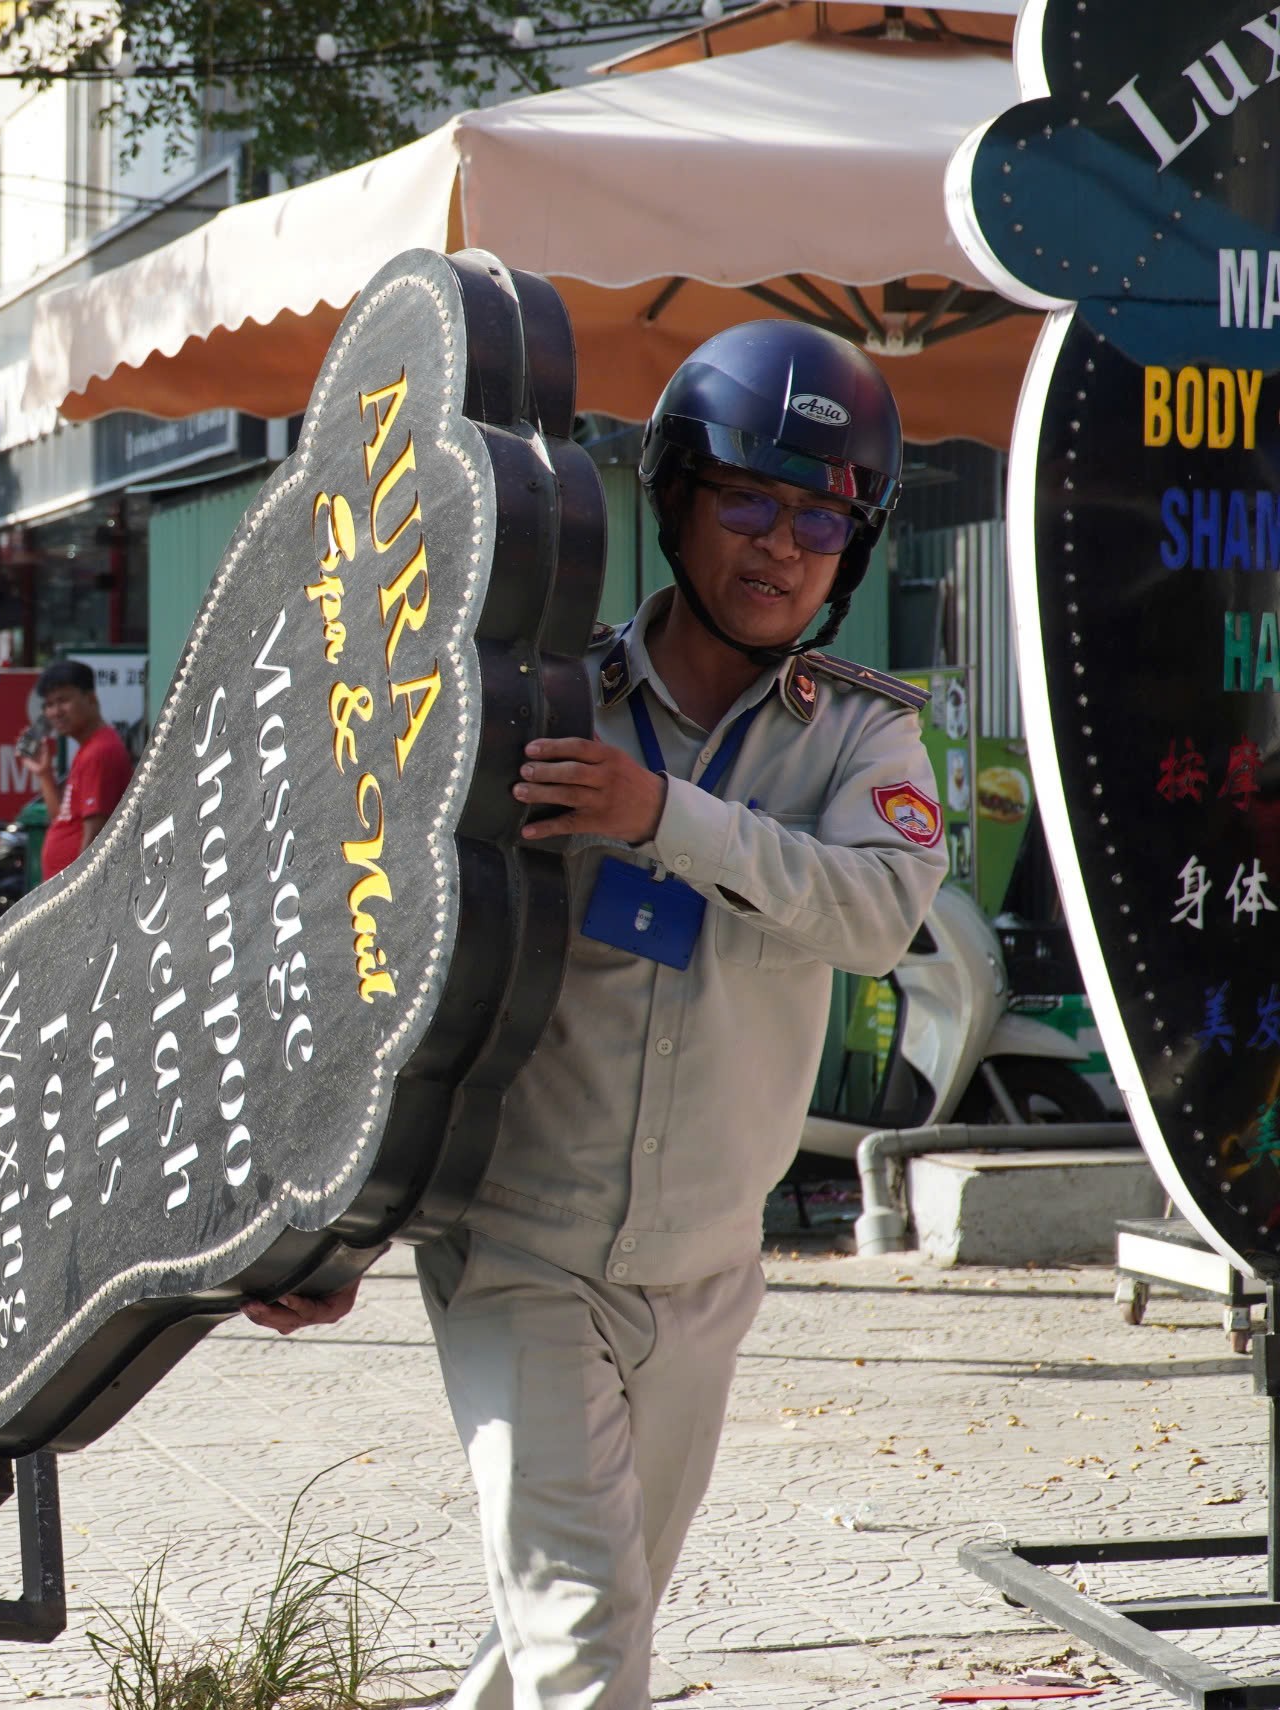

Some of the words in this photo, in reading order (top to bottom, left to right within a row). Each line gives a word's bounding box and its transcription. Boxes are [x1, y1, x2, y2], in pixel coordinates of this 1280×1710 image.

[797, 398, 841, 421] Asia
[1144, 366, 1264, 450] BODY
[304, 490, 357, 665] Spa
[358, 363, 442, 782] AURA
[328, 680, 375, 776] &
[1156, 734, 1265, 812] 按摩
[192, 686, 254, 1188] Shampoo
[248, 604, 315, 1073] Massage
[340, 771, 401, 1005] Nail
[1170, 854, 1279, 930] 身体
[37, 1012, 74, 1230] Foot
[86, 940, 131, 1206] Nails
[134, 814, 200, 1218] Eyelash
